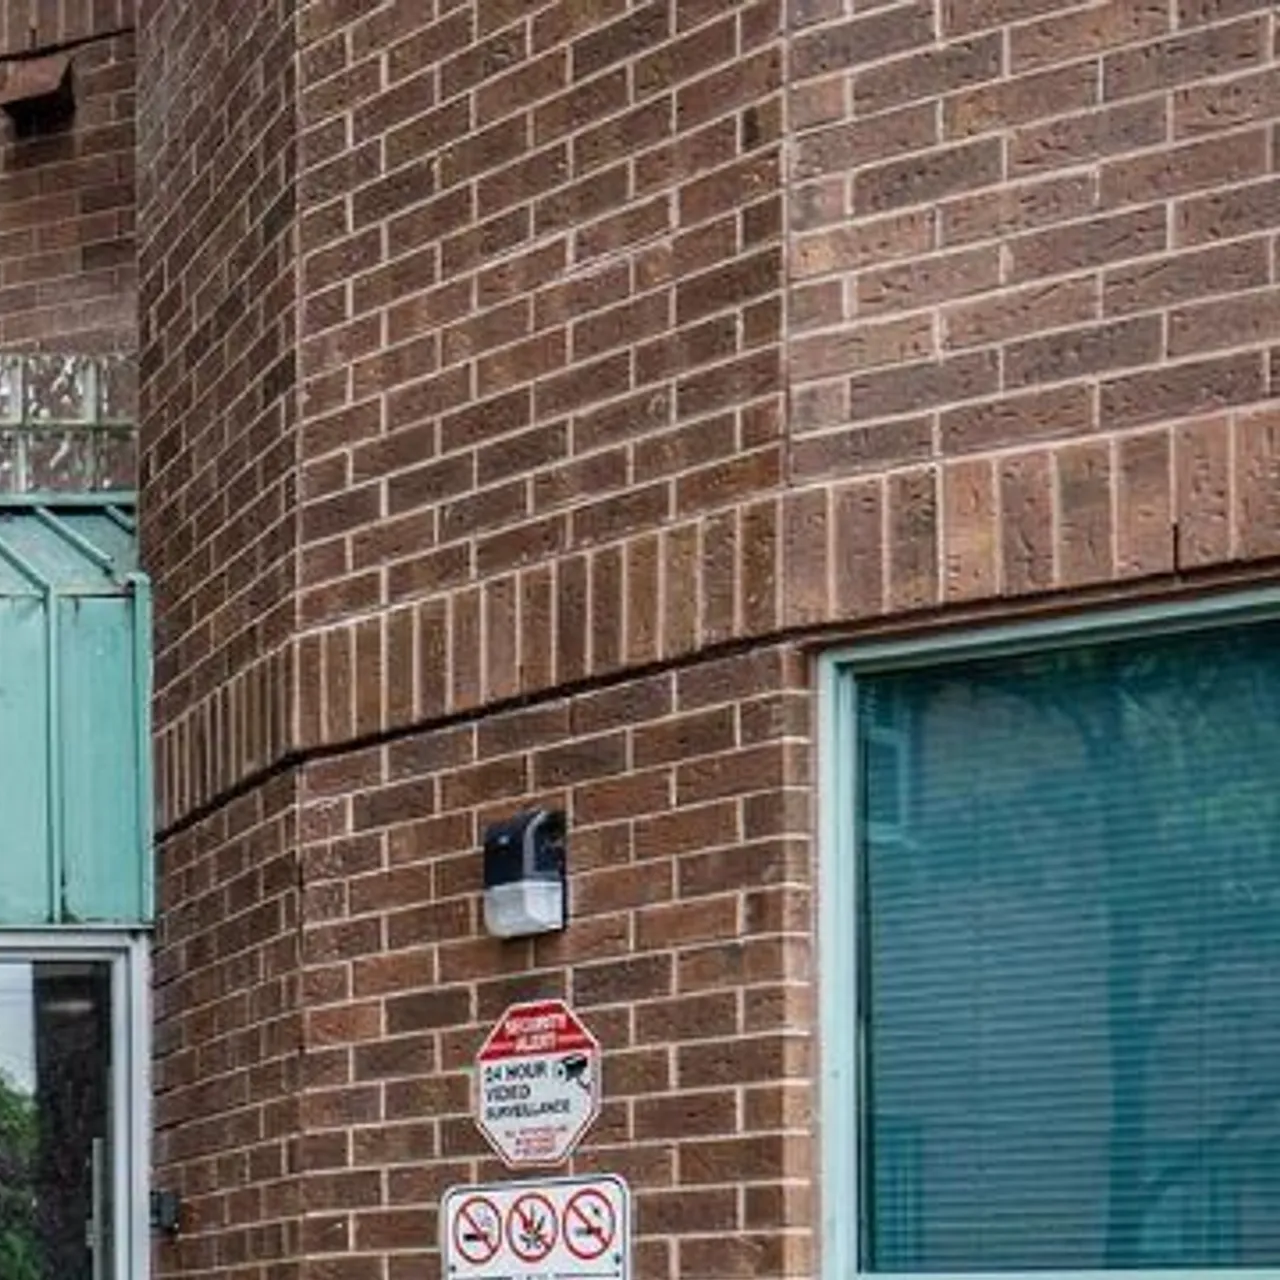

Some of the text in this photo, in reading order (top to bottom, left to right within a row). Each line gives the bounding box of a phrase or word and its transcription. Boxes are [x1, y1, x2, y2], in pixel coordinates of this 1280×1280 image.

[506, 1061, 547, 1081] HOUR
[484, 1083, 532, 1102] VIDEO
[484, 1099, 572, 1122] SURVEILLANCE
